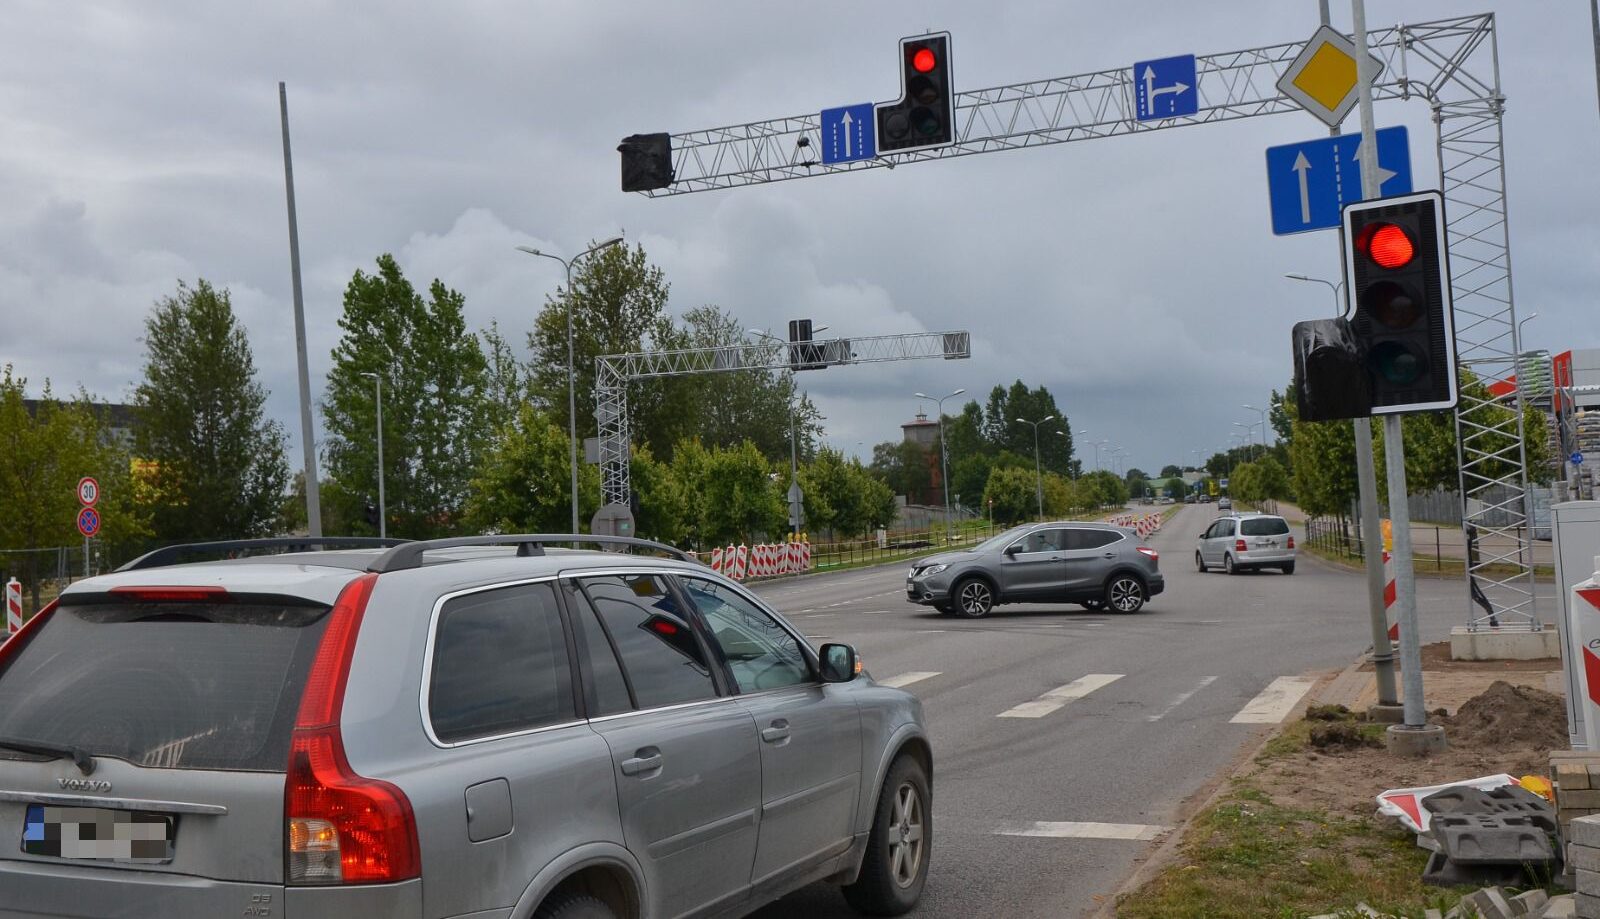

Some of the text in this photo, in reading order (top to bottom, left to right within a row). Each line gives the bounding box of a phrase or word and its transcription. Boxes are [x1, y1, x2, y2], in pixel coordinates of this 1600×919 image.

[84, 485, 94, 499] 30
[57, 778, 112, 792] VOLVO
[243, 906, 270, 917] AWD
